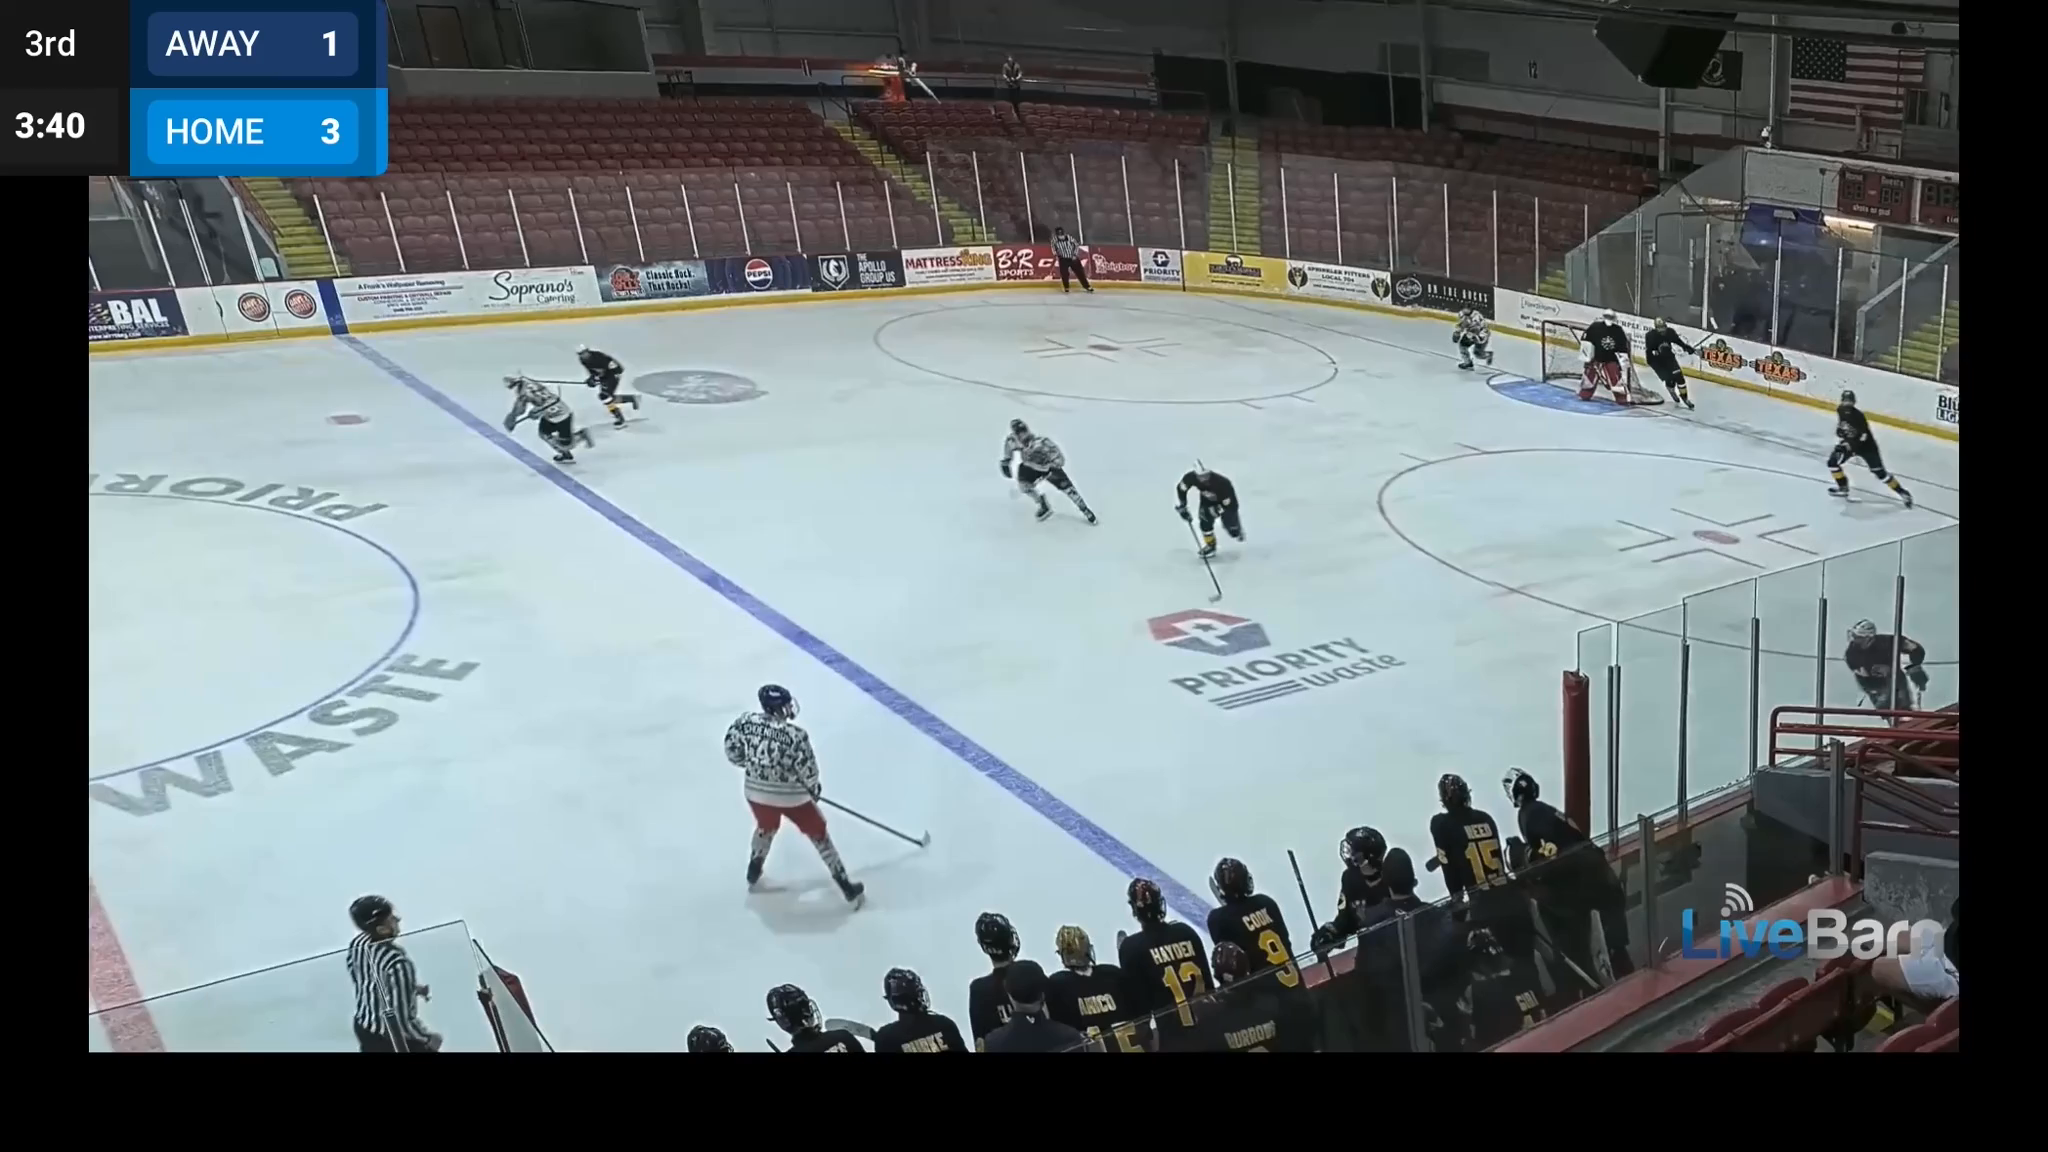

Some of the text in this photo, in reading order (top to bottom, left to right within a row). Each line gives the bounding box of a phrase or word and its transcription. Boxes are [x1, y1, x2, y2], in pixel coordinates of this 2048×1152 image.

[856, 253, 867, 261] THE
[858, 260, 887, 272] APOLLO
[905, 256, 963, 270] MATTRESS
[645, 270, 673, 280] Classic
[747, 270, 772, 278] PEPSI
[859, 272, 884, 284] GROUP
[885, 271, 896, 282] US
[999, 269, 1034, 278] SPORTS
[1144, 268, 1181, 276] PRIORITY
[1321, 274, 1342, 282] LOCAL
[488, 271, 574, 303] Soprano's
[648, 282, 665, 291] That
[536, 294, 576, 304] Catering
[107, 298, 168, 326] BAL
[1703, 348, 1742, 367] TEXAS
[1760, 361, 1800, 379] TEXAS
[1169, 637, 1372, 695] PRIORITY
[1300, 653, 1406, 688] waste
[89, 654, 481, 817] WASTE
[1464, 822, 1493, 840] REED
[1465, 838, 1507, 890] 15
[1242, 908, 1273, 931] COOK
[1149, 940, 1196, 965] HAYDEN
[1258, 929, 1299, 988] 9
[1162, 961, 1206, 1027] 12
